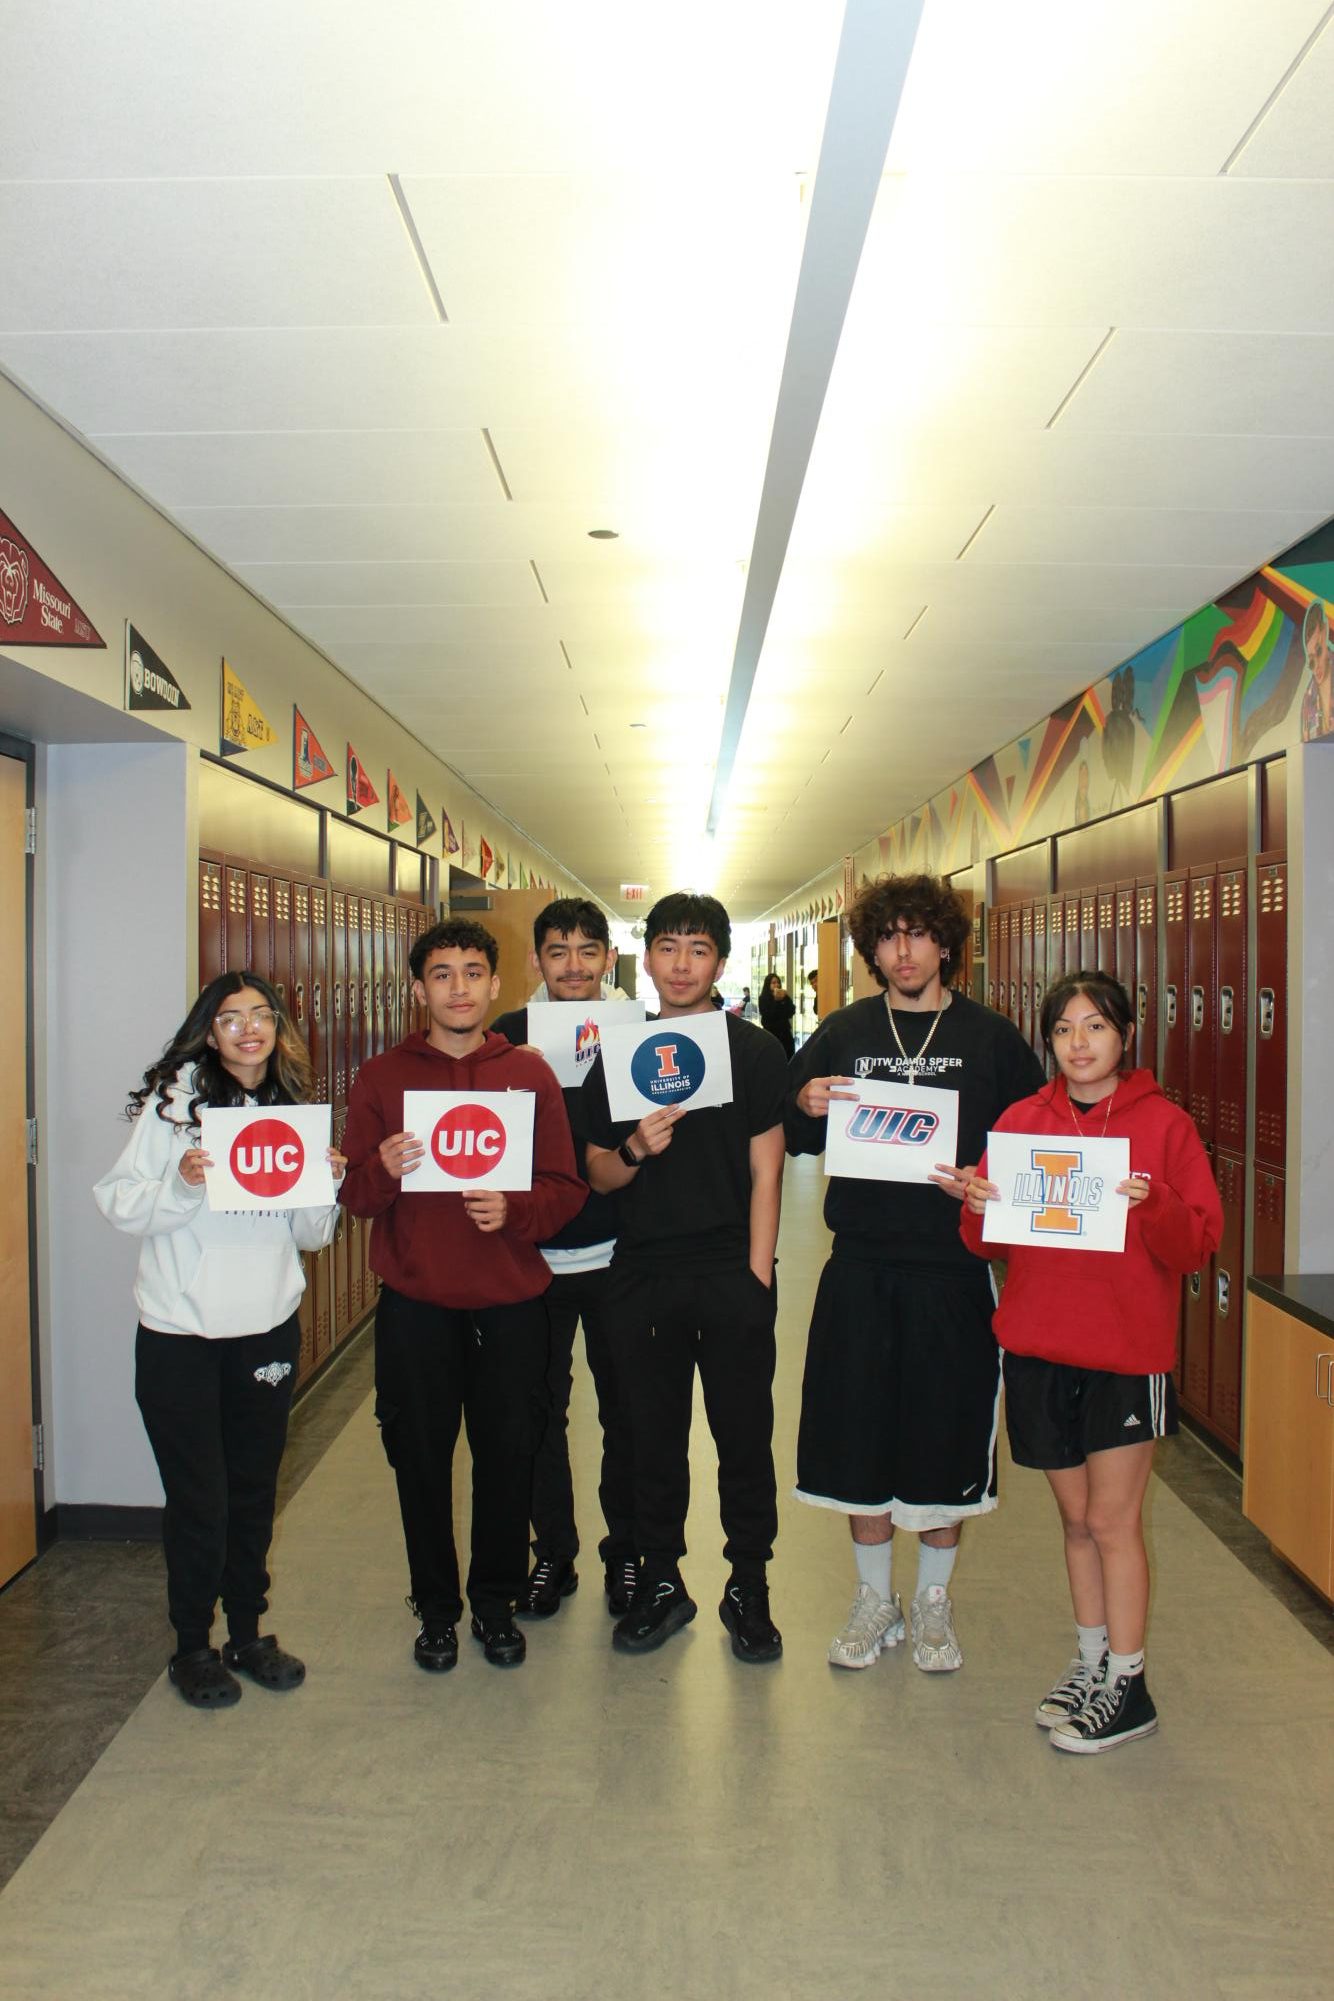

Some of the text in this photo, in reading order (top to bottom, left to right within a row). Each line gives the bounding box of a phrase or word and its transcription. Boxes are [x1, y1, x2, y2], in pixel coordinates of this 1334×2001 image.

[33, 578, 71, 619] Missouri
[41, 604, 63, 634] State
[144, 668, 180, 708] BOWDOIN
[626, 888, 643, 900] EXIT
[873, 1057, 893, 1067] ITW
[929, 1057, 963, 1067] SPEER
[651, 1079, 691, 1092] ILLINOIS
[847, 1105, 939, 1146] UIC
[438, 1129, 502, 1157] UIC
[236, 1144, 300, 1175] UIC
[1013, 1172, 1104, 1206] ILLINOIS
